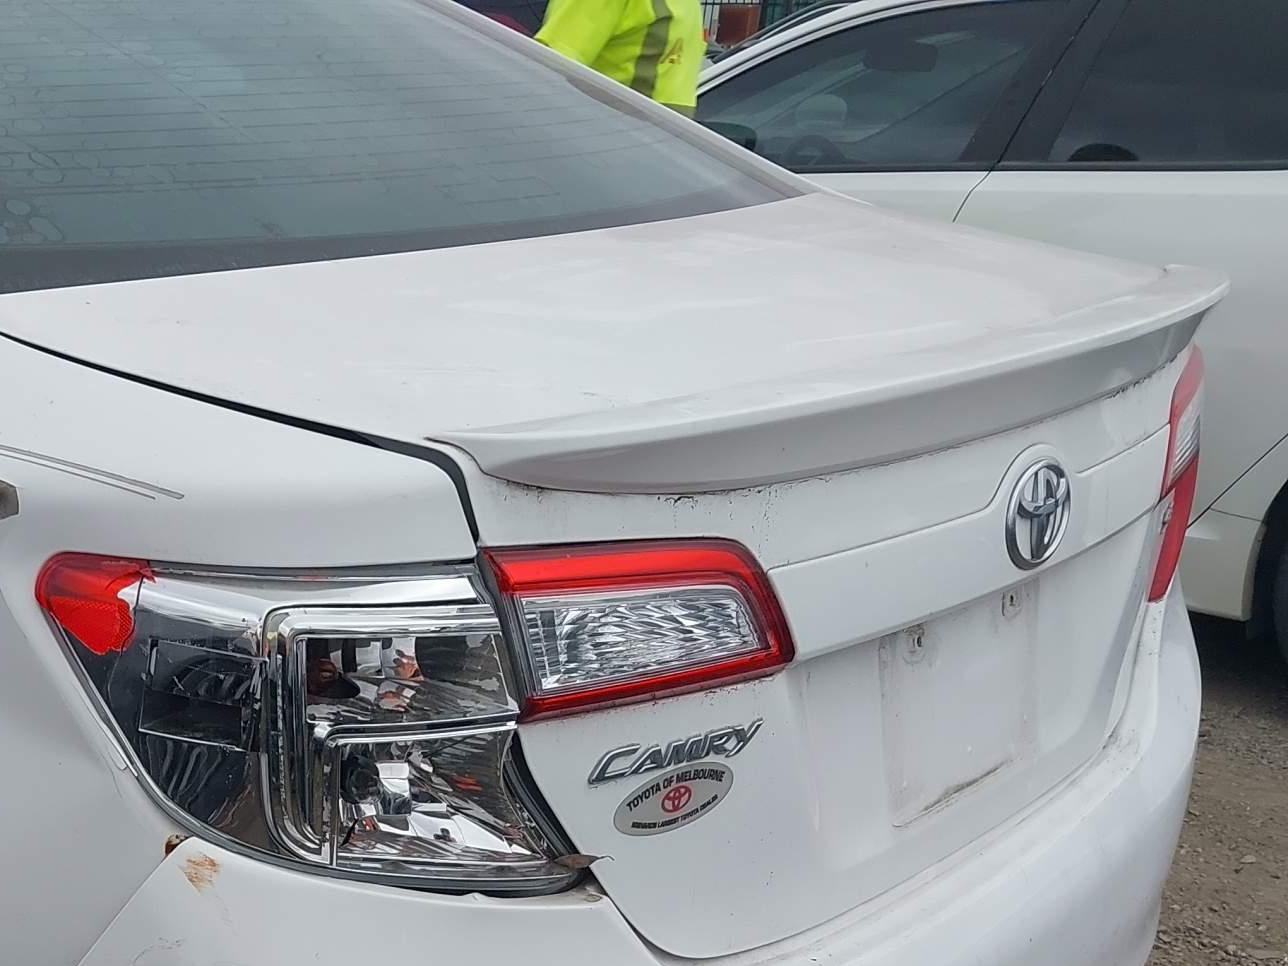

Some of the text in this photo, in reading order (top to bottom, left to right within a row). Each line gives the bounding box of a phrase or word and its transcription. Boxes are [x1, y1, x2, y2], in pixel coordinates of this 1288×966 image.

[588, 718, 764, 784] CAMRY
[626, 768, 726, 812] TOYOTA OF MELBOURNE
